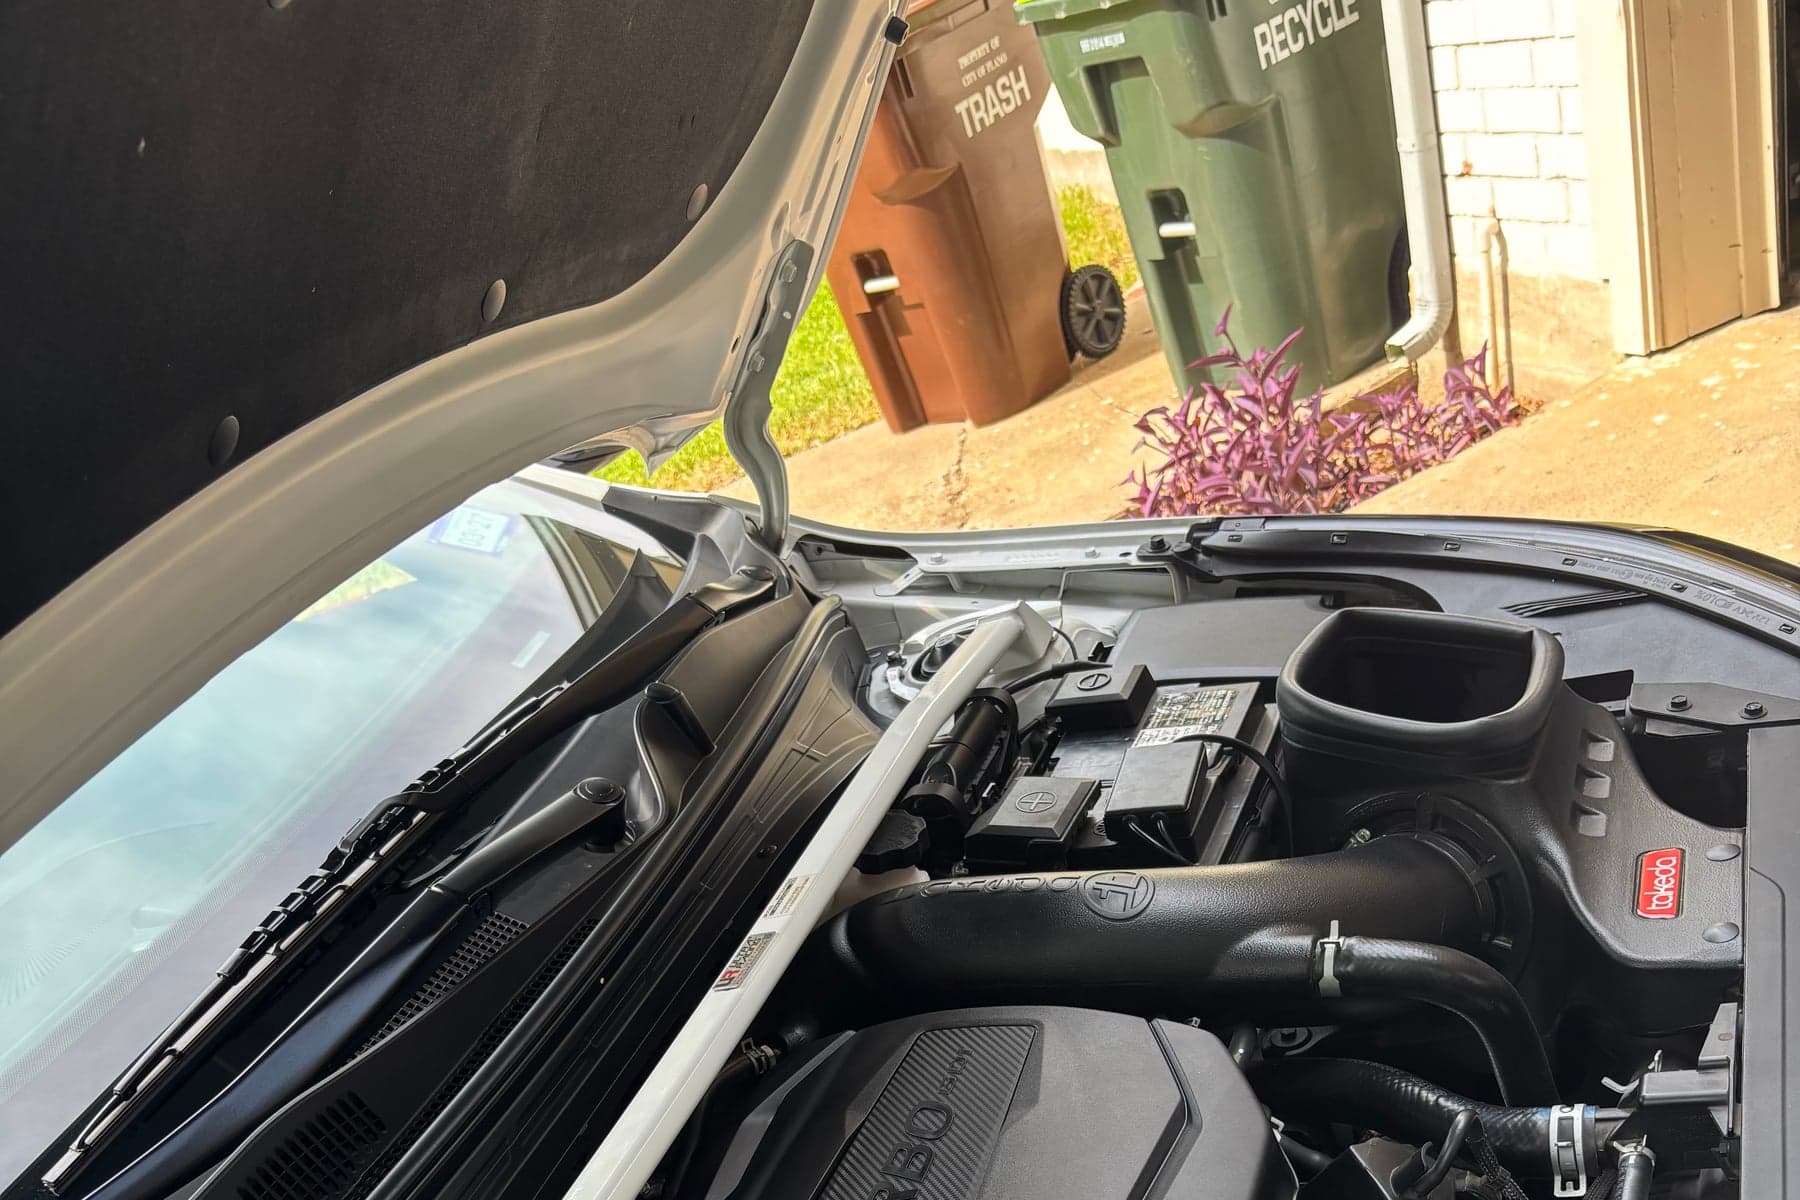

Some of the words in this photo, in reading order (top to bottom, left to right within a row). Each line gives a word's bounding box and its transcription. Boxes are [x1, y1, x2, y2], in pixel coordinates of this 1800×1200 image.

[1253, 0, 1360, 71] RECYCLE
[955, 64, 1031, 138] TRASH
[1645, 856, 1677, 911] takeda
